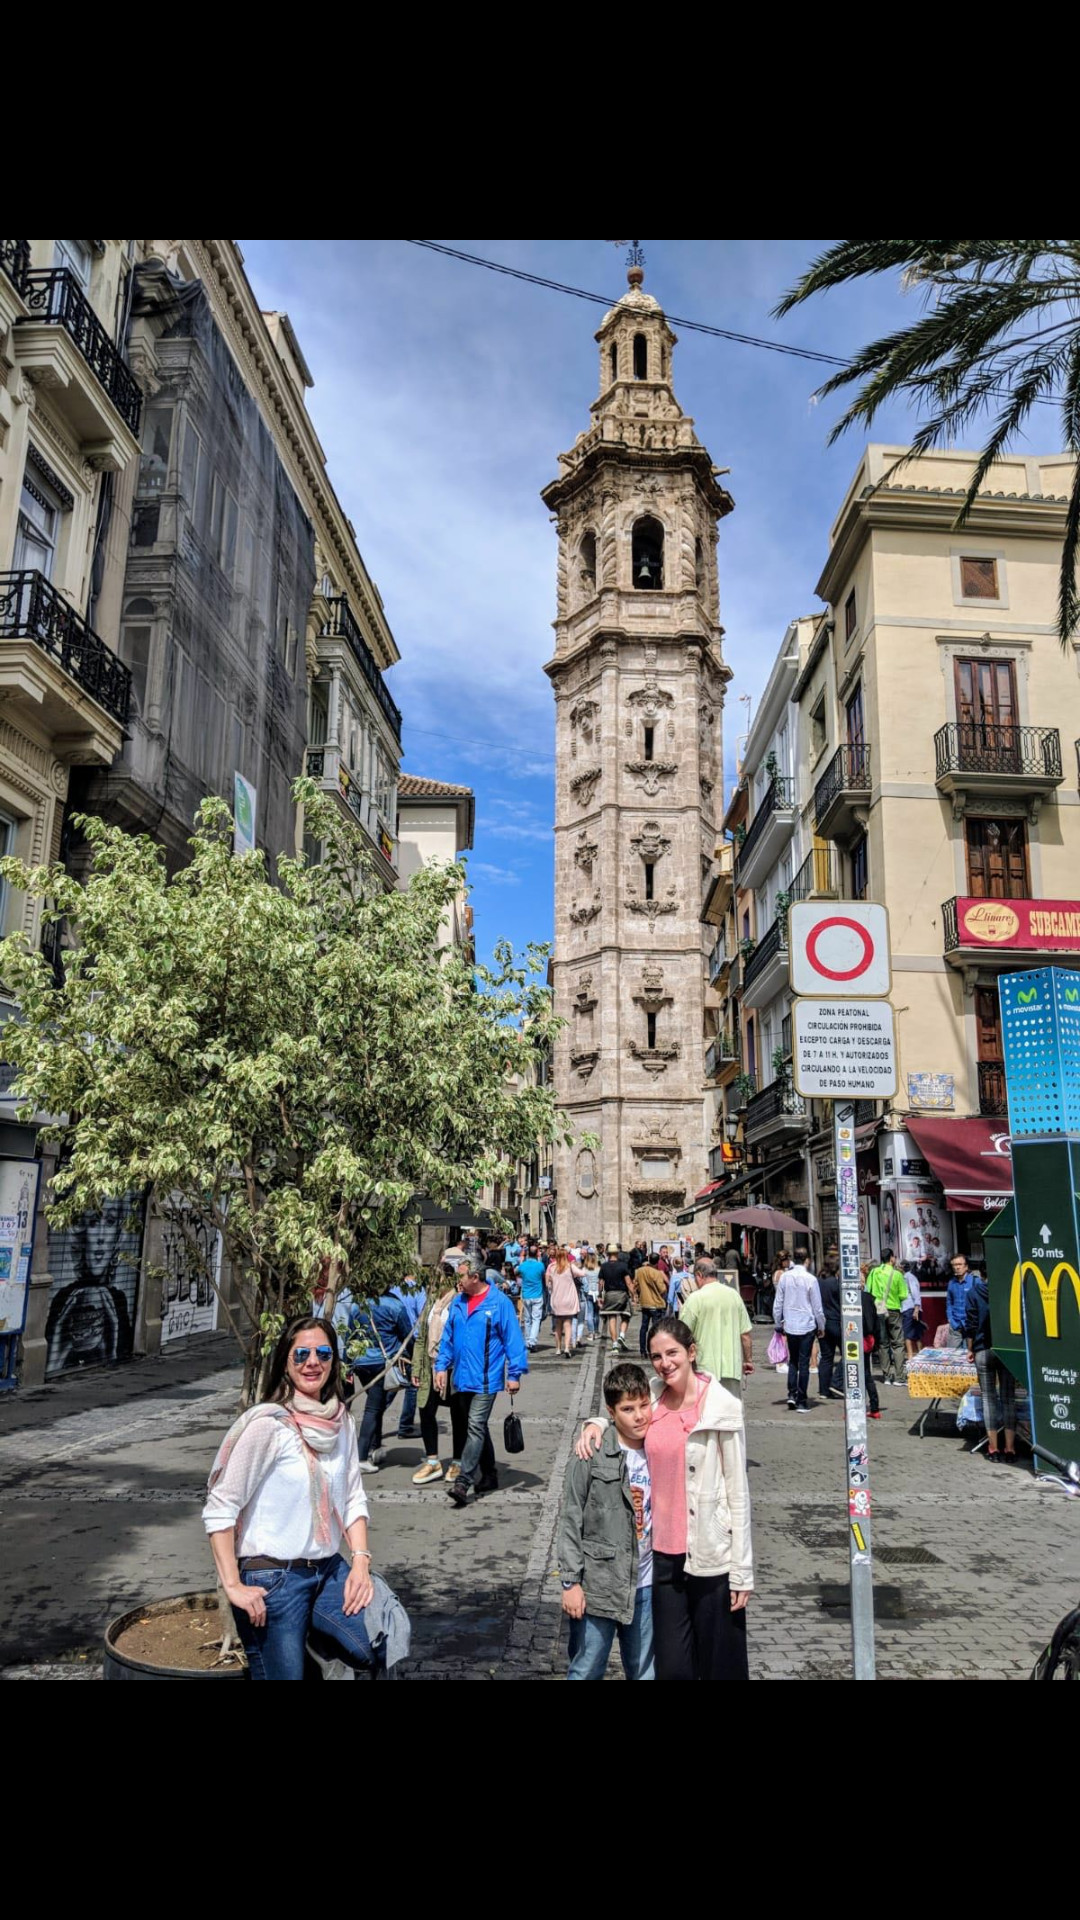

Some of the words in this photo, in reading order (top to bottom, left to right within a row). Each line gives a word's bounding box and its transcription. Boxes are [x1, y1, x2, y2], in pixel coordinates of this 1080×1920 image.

[819, 1008, 835, 1016] ZONA
[838, 1008, 869, 1017] PEATONAL
[1013, 1004, 1043, 1014] movistar
[850, 1023, 882, 1031] PROHIBIDA
[800, 1036, 827, 1044] EXCEPTO
[830, 1037, 850, 1045] CARGA
[858, 1037, 891, 1046] DESCARGA
[803, 1050, 811, 1058] DE
[846, 1051, 889, 1060] AUTORIZADOS
[801, 1064, 840, 1072] CIRCULANDO
[849, 1066, 856, 1074] LA
[858, 1066, 892, 1074] VELOCIDAD
[819, 1079, 827, 1088] DE
[829, 1080, 846, 1088] PASO
[848, 1080, 875, 1088] HUMANO
[1032, 1248, 1044, 1258] 50
[1045, 1248, 1064, 1258] mts
[1042, 1367, 1059, 1376] Plaza
[1060, 1369, 1069, 1377] de
[1070, 1369, 1078, 1377] la
[1044, 1375, 1065, 1384] Reina,
[1049, 1394, 1071, 1404] Wi-Fi
[1050, 1419, 1076, 1431] Gratis
